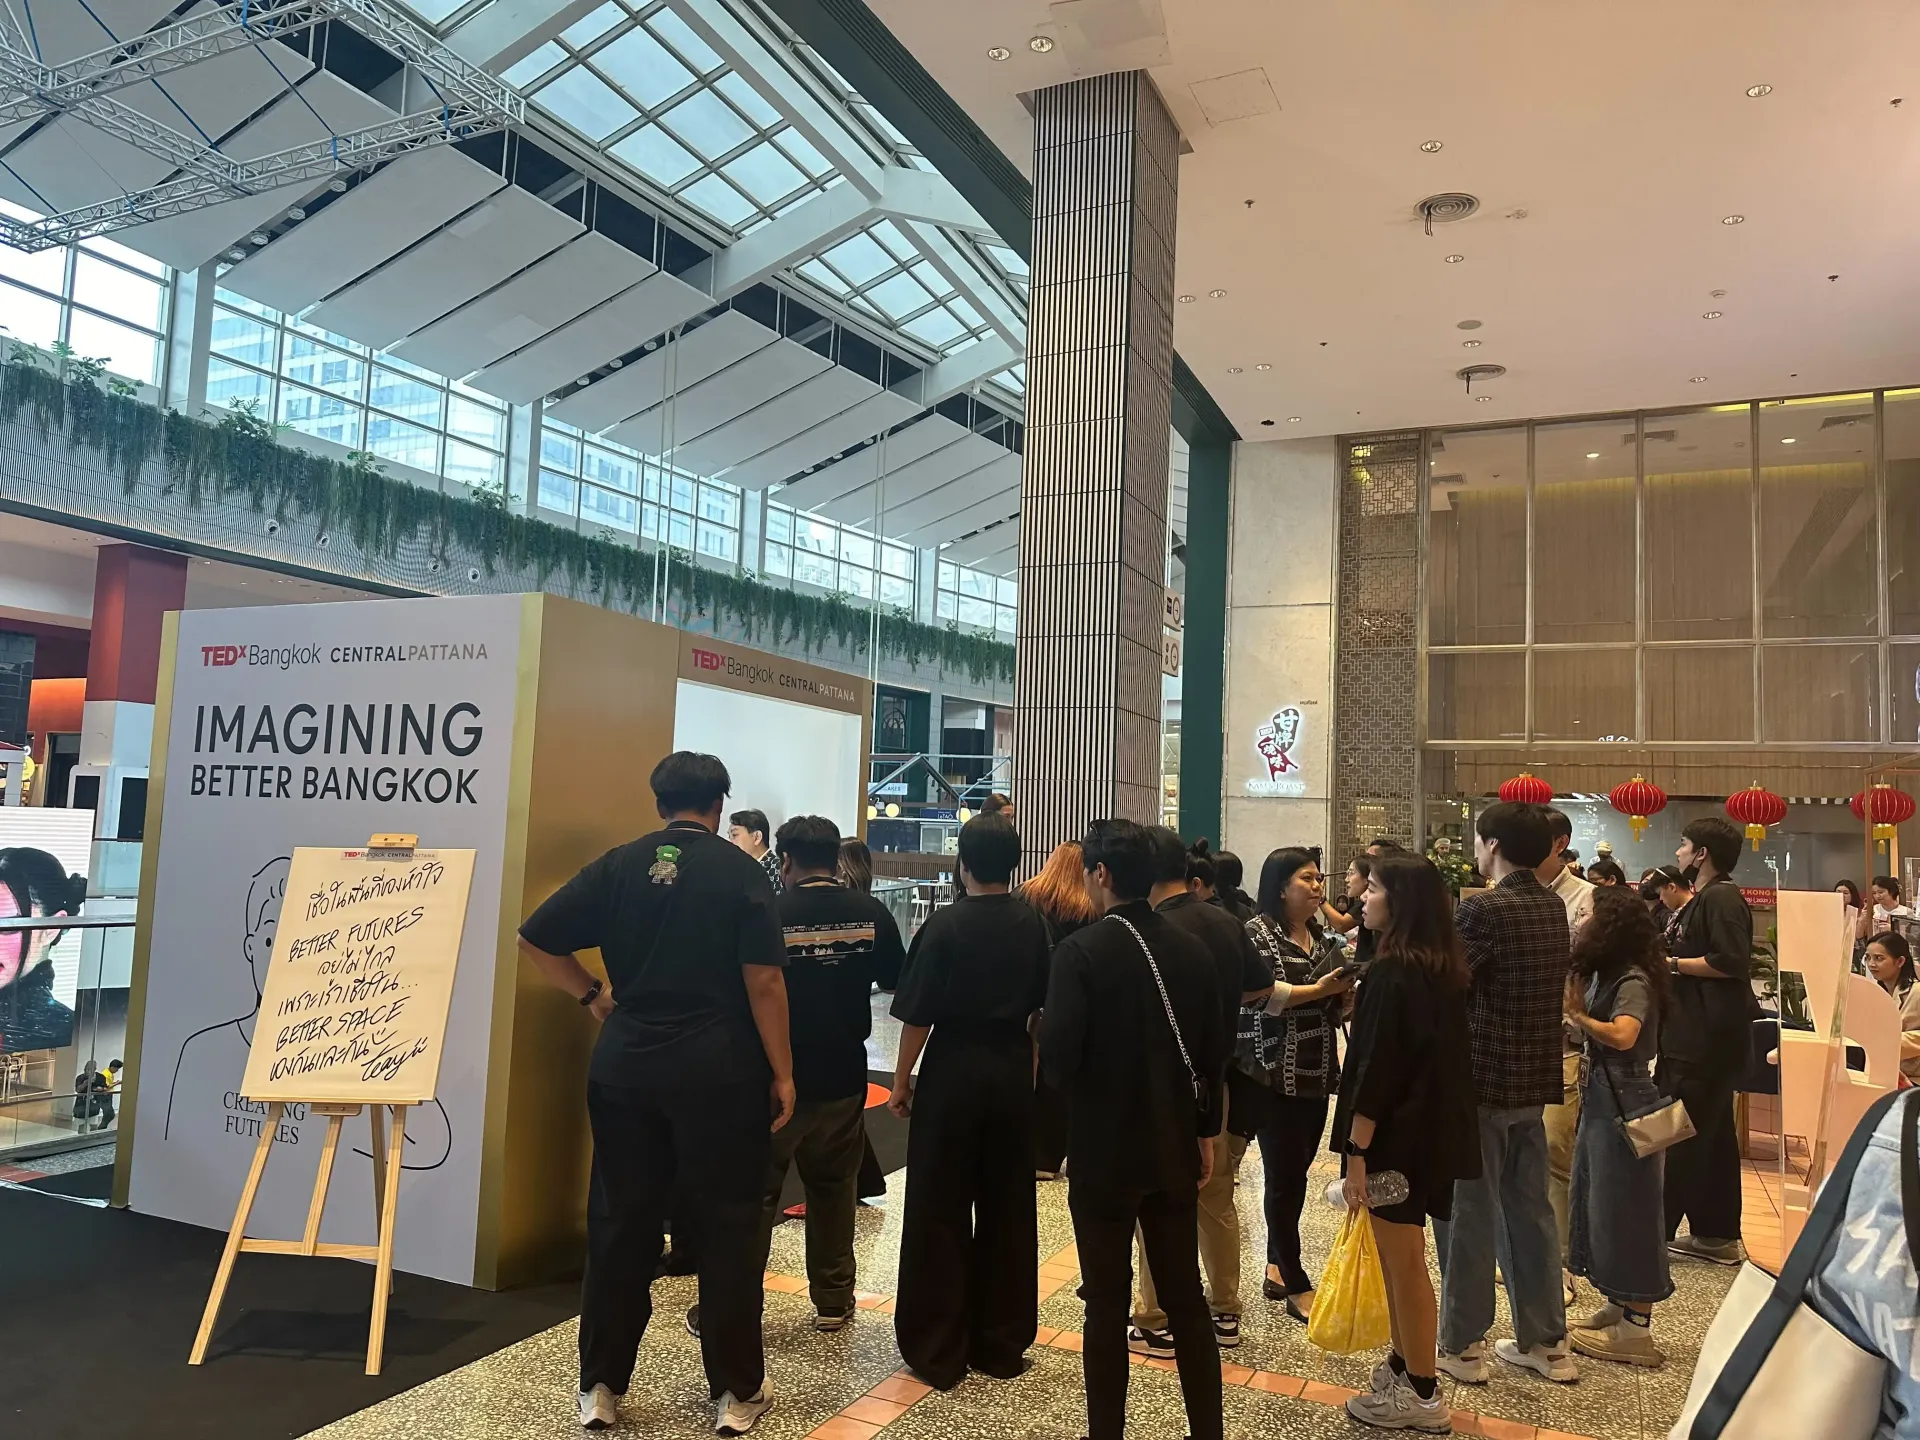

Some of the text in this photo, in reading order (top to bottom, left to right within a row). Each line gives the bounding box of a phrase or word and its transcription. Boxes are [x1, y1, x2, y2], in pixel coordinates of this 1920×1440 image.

[330, 643, 489, 664] CENTRALPATTANA
[778, 673, 856, 703] CENTRALPATTANA
[194, 702, 484, 757] IMAGINING
[190, 763, 481, 805] BETTER BANGKOK
[288, 906, 425, 962] BETTER FUTURES
[275, 996, 412, 1052] BETTER SPACE
